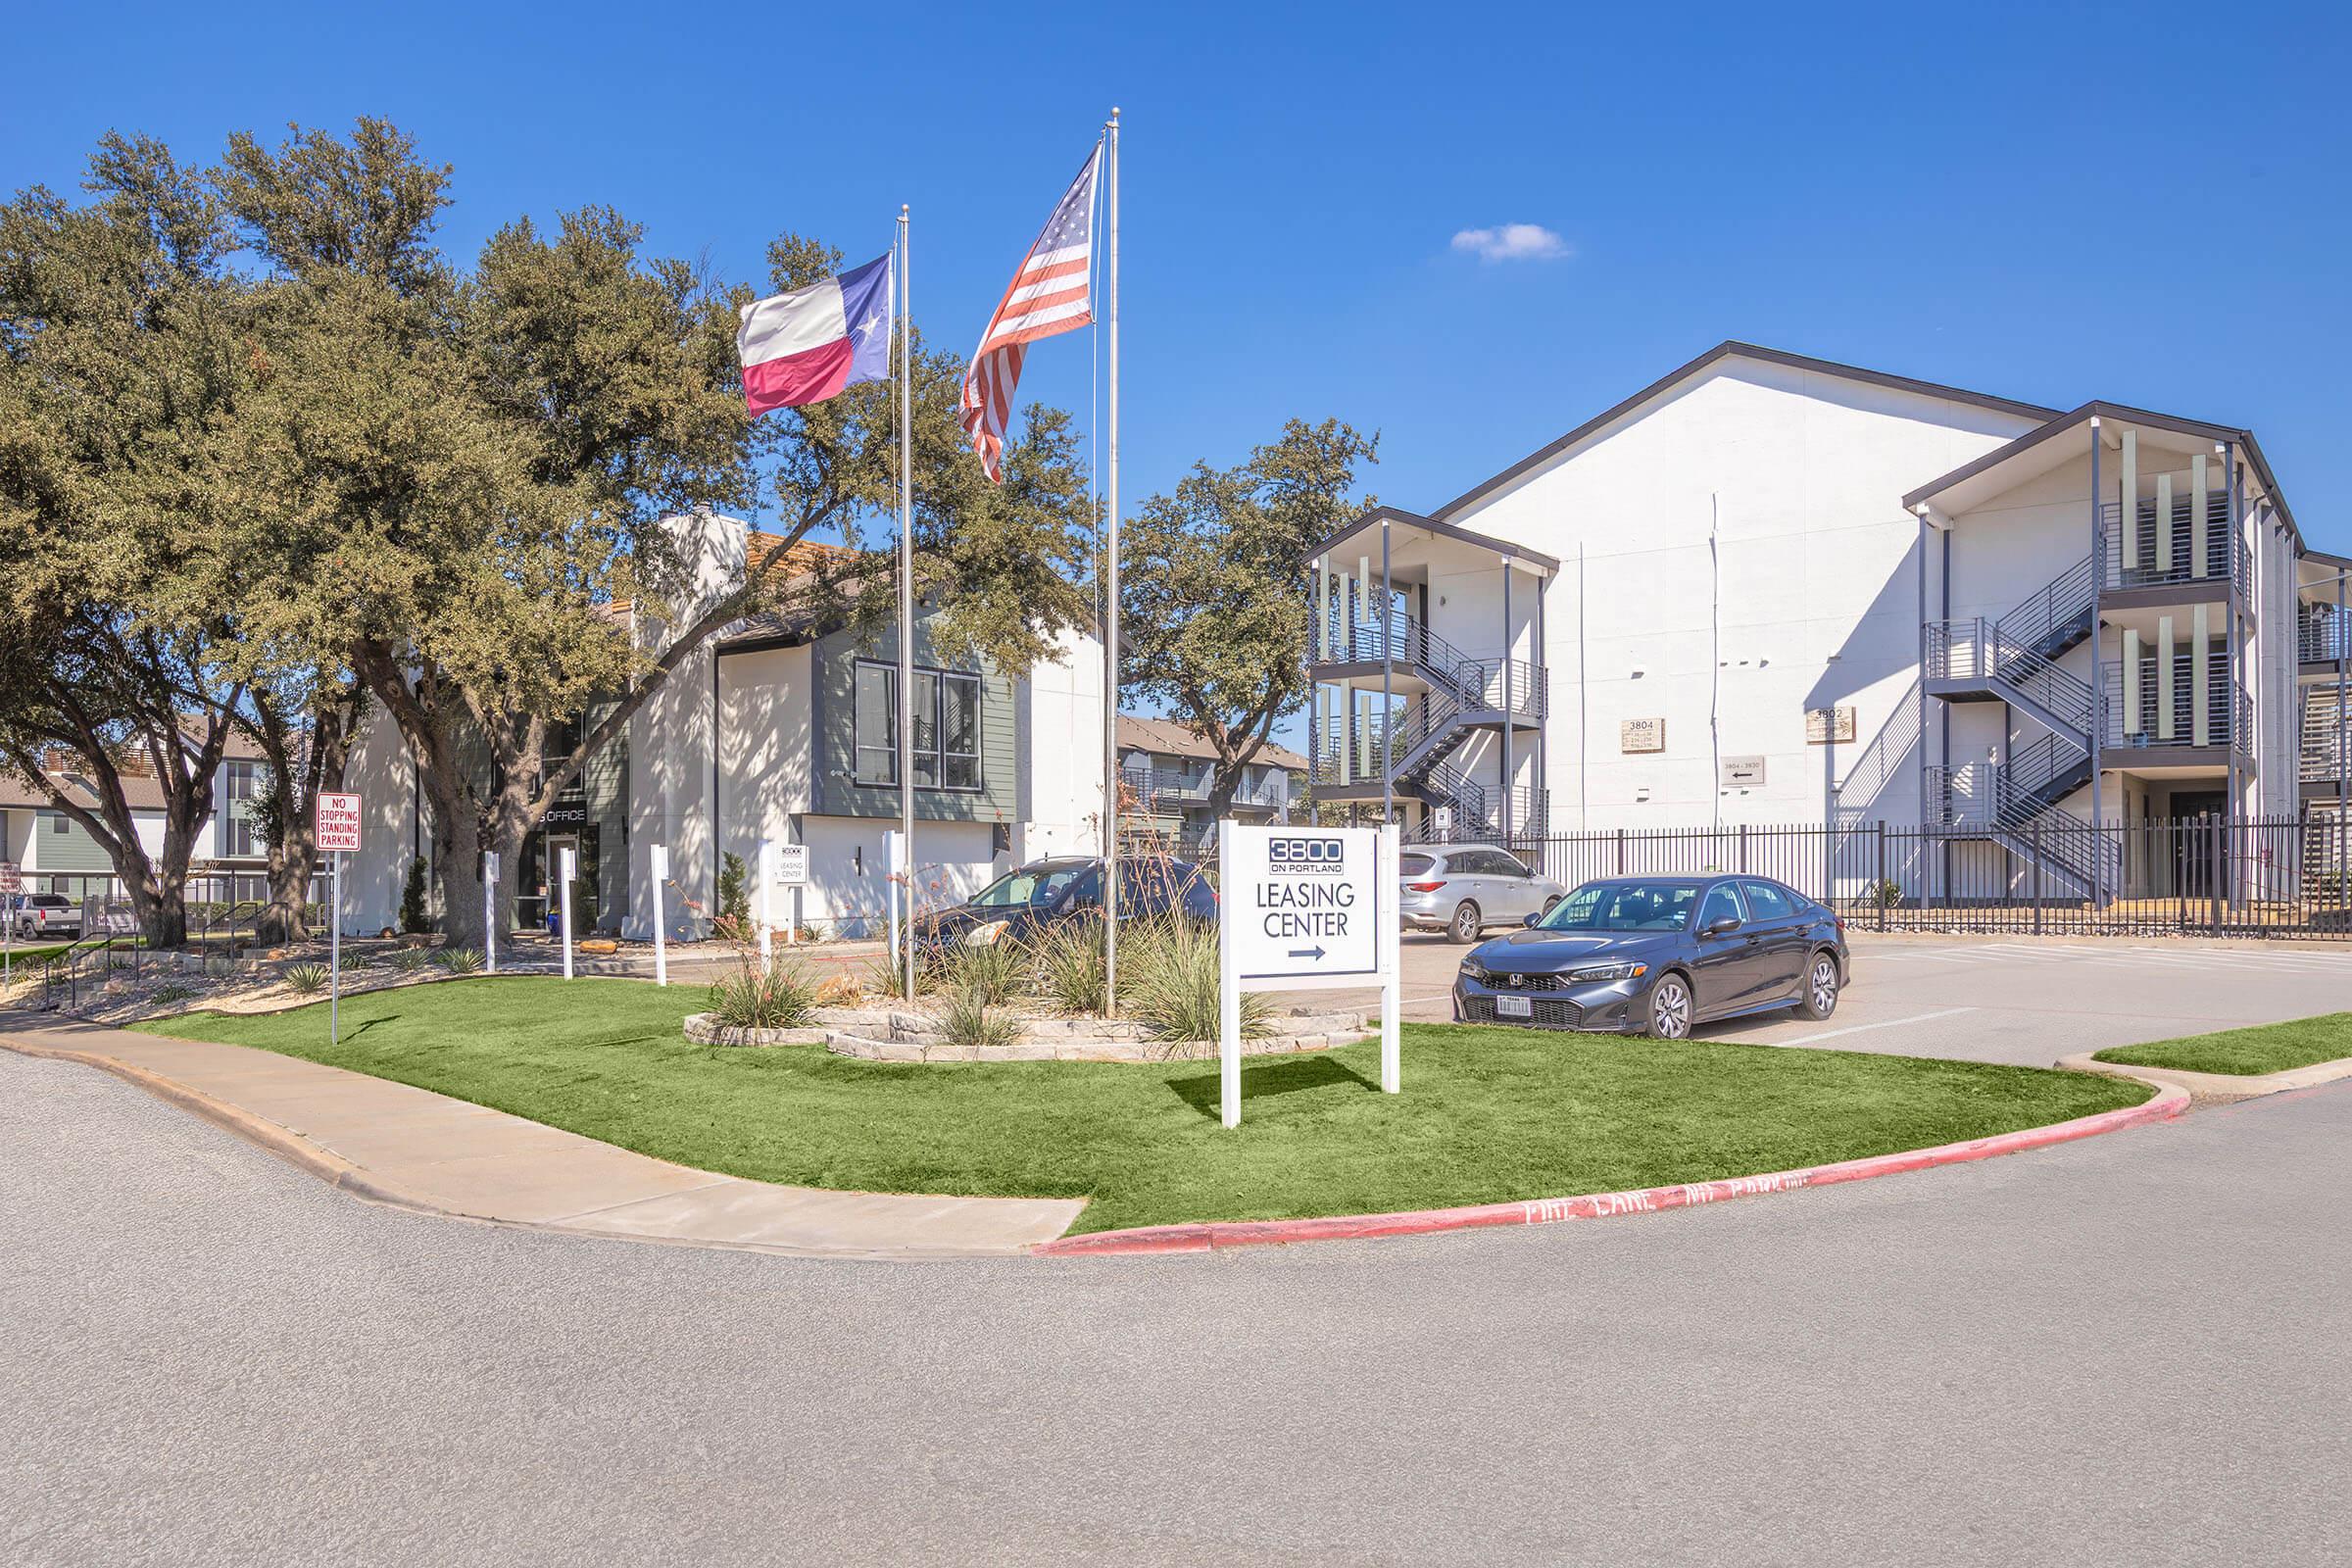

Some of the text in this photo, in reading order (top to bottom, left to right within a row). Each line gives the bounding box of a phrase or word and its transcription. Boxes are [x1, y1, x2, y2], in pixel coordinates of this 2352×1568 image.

[1816, 709, 1842, 718] 3802
[1630, 720, 1653, 730] 3804
[332, 798, 346, 808] NO
[320, 809, 358, 822] STOPPING
[547, 809, 585, 822] OFFICE
[320, 822, 358, 834] STANDING
[320, 834, 356, 847] PARKING
[1271, 839, 1342, 861] 3800
[1271, 863, 1343, 873] ON PORTLAND
[1257, 882, 1355, 908] LEASING
[1263, 911, 1348, 938] CENTER
